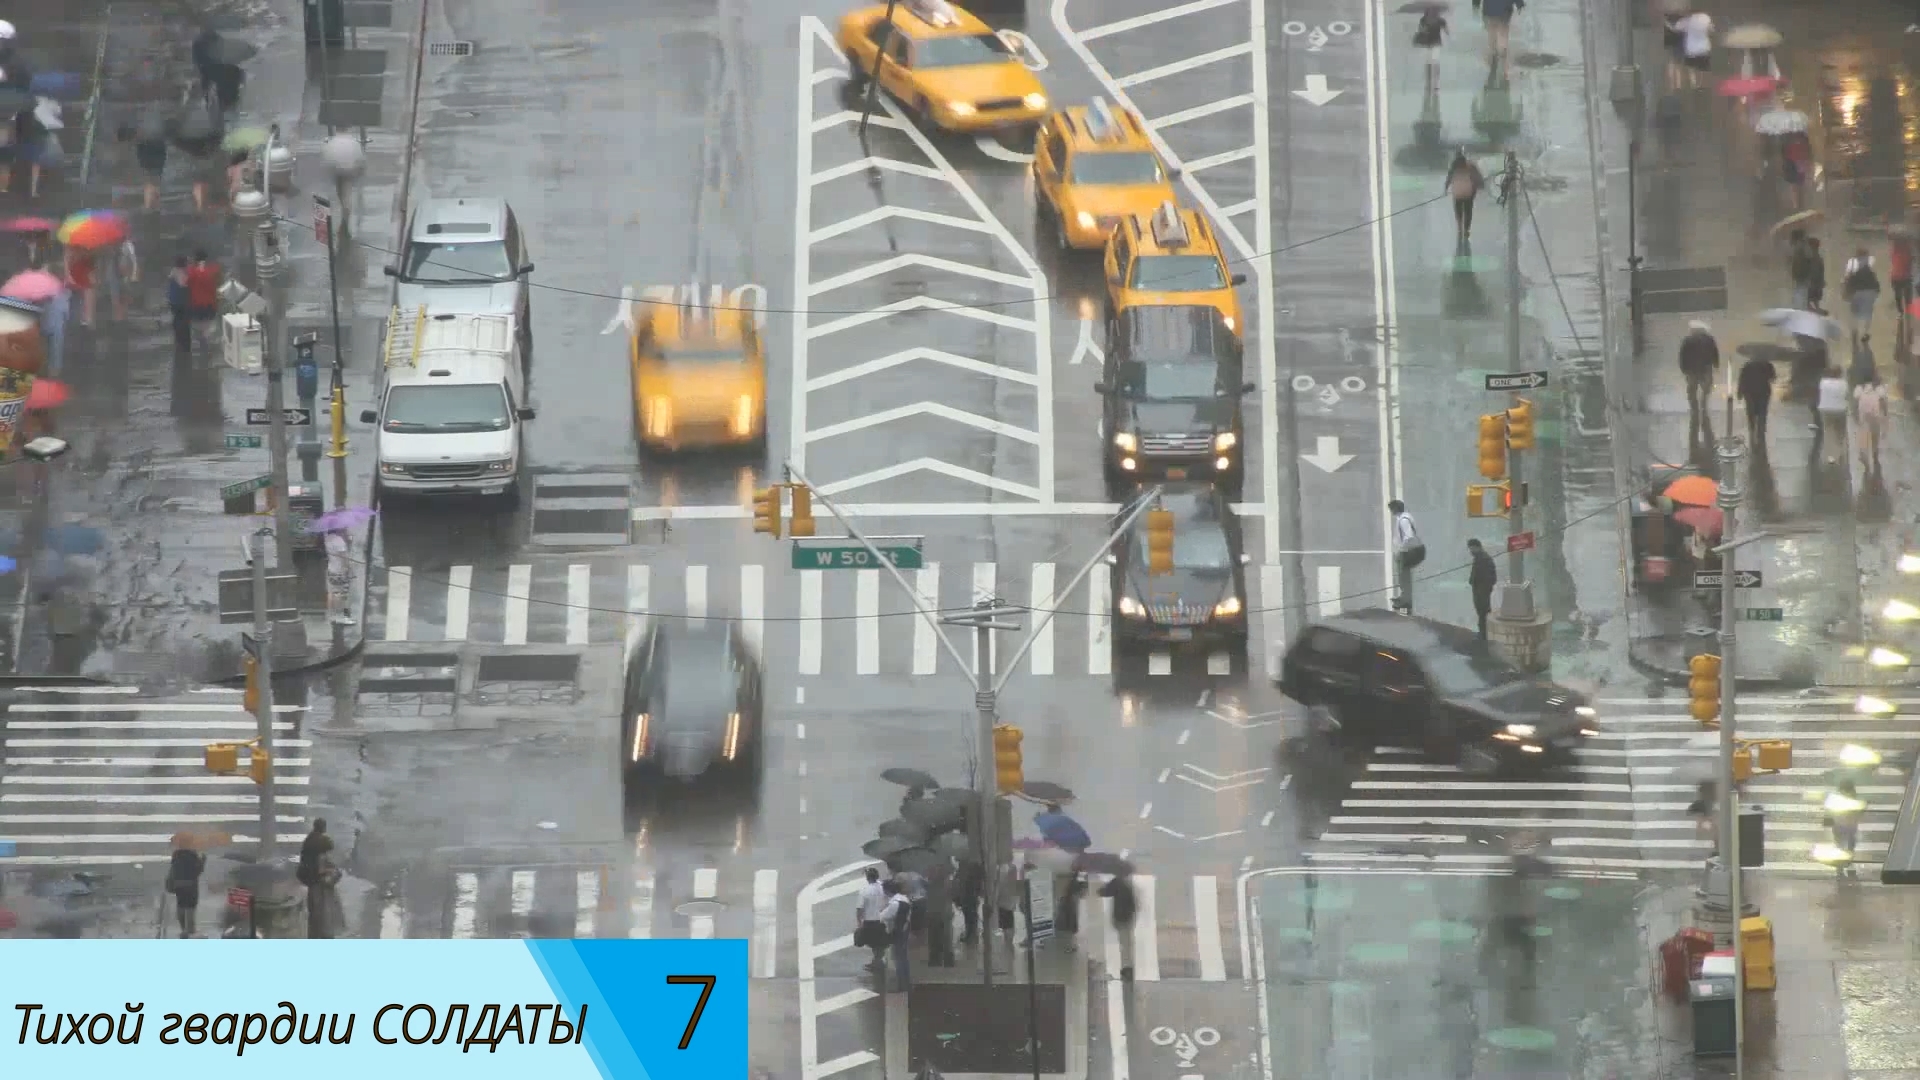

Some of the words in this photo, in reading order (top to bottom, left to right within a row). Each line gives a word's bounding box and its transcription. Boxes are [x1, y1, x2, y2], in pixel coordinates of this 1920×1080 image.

[1520, 376, 1537, 384] WAY
[816, 552, 833, 565] W
[841, 552, 869, 564] 50
